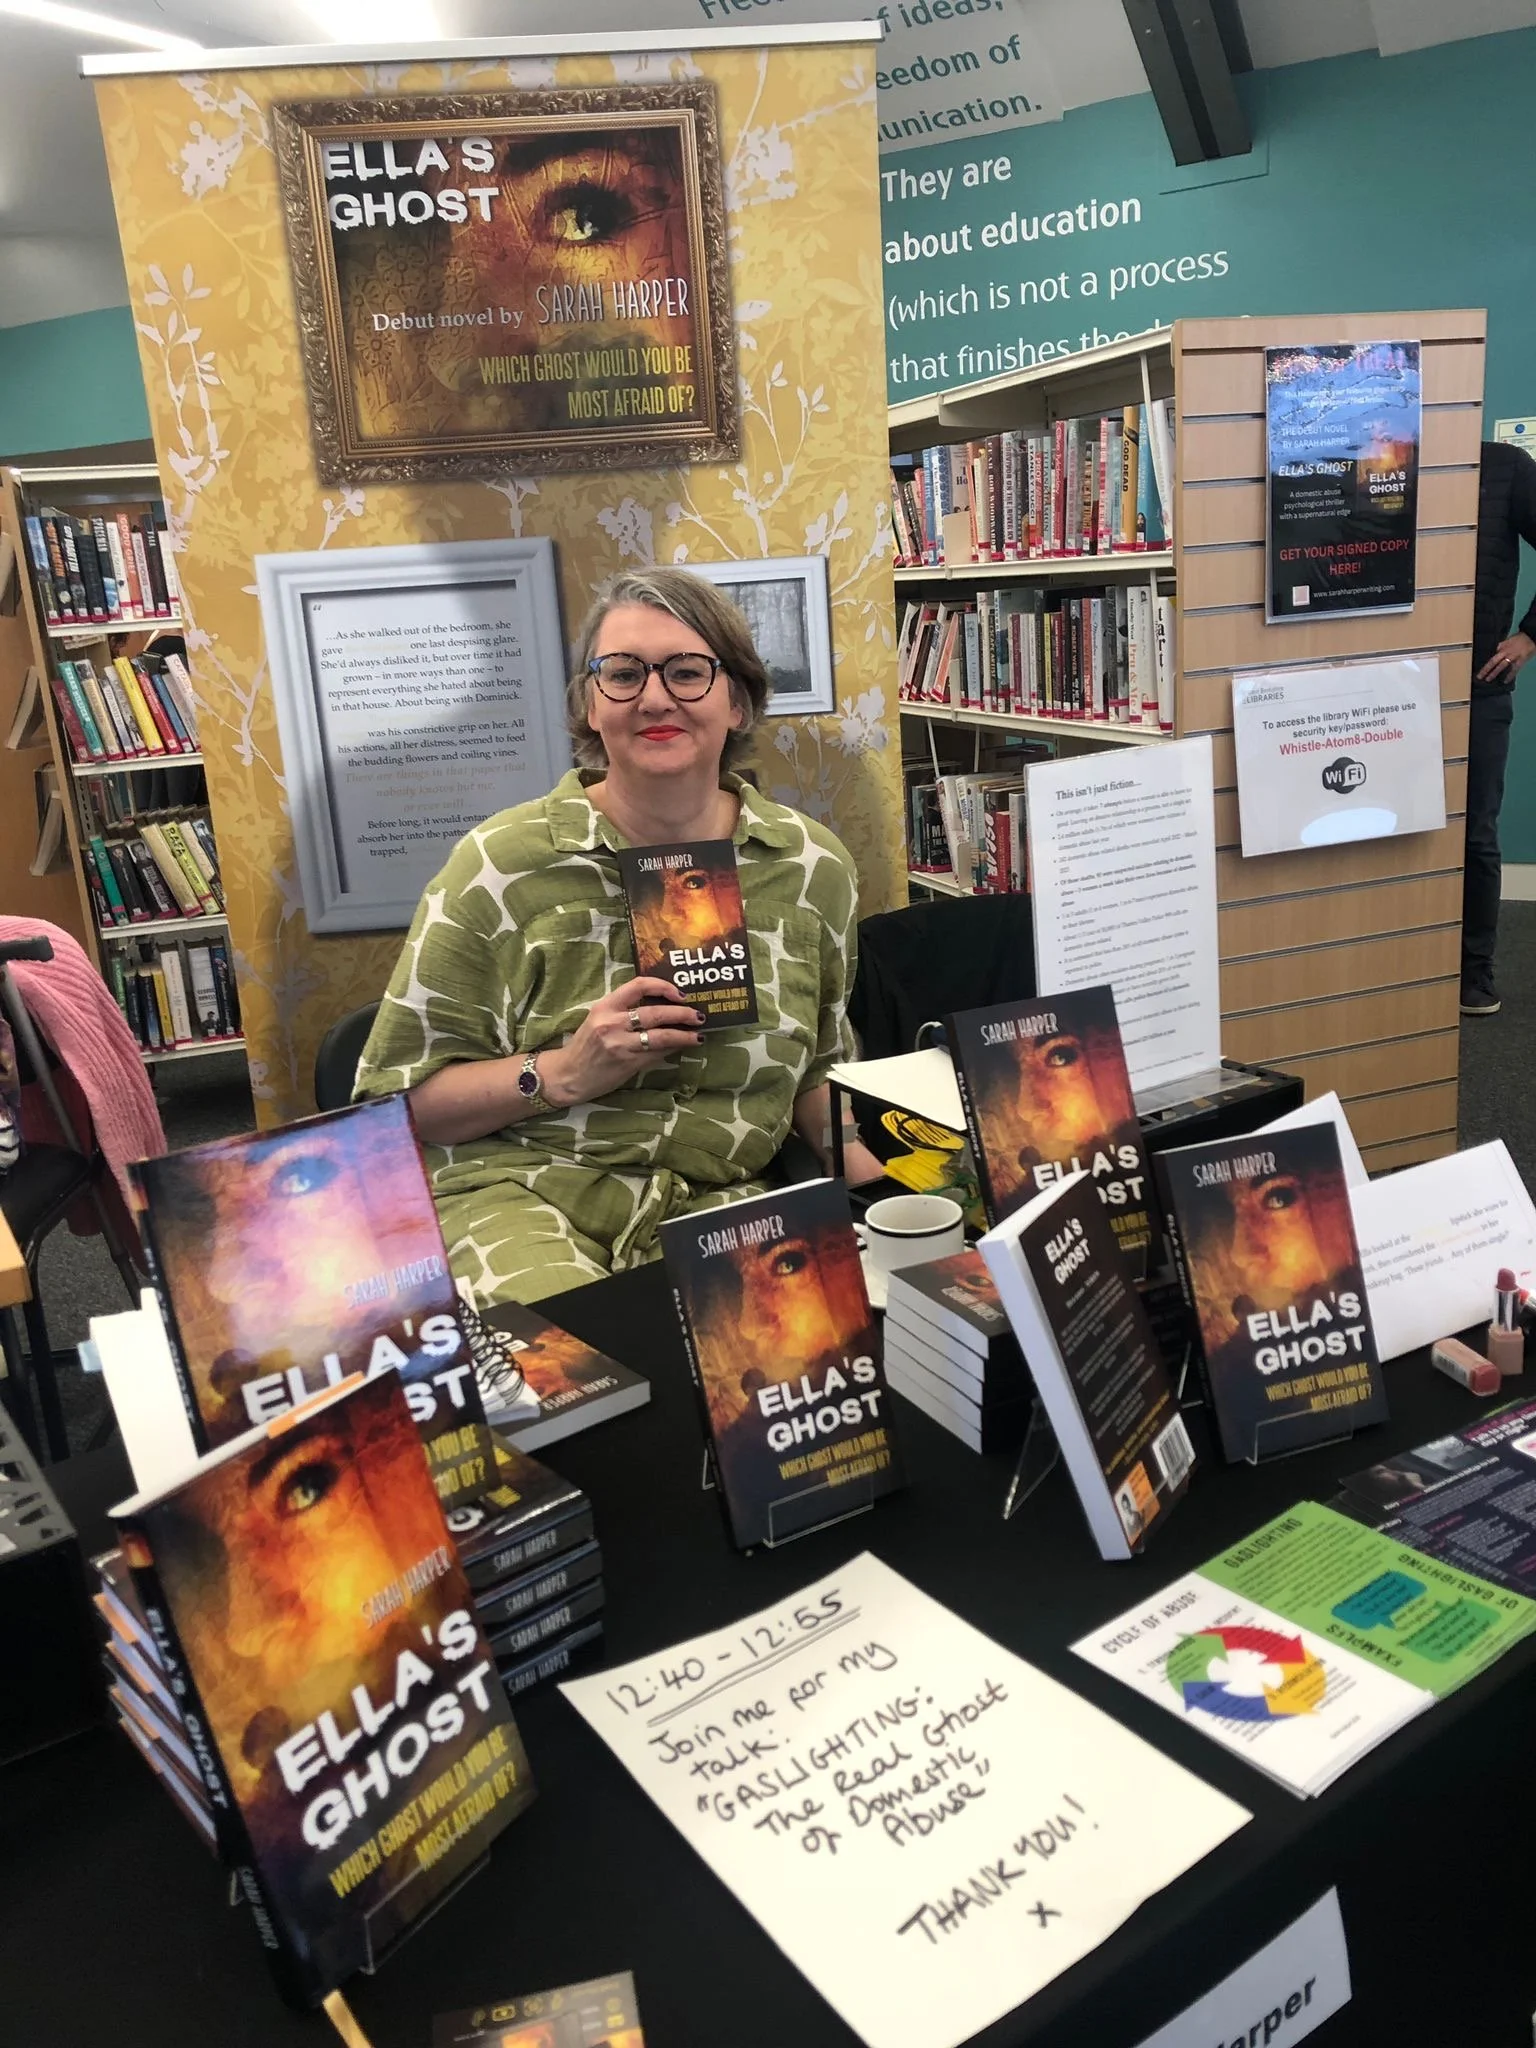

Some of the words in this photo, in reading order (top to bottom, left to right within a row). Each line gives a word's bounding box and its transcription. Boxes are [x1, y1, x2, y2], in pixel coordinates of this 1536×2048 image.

[876, 47, 981, 91] eedom
[989, 33, 1021, 65] of
[879, 91, 1042, 142] unication.
[323, 137, 496, 181] ELLA'S
[880, 165, 954, 202] They
[962, 154, 1012, 183] are
[329, 187, 499, 230] GHOST
[884, 227, 973, 264] about
[982, 197, 1141, 247] education
[372, 311, 436, 331] Debut
[439, 308, 494, 327] novel
[499, 309, 524, 328] by
[535, 286, 604, 325] SARAH
[613, 278, 689, 319] HARPER
[889, 283, 979, 329] (which
[989, 283, 1010, 311] is
[1019, 272, 1070, 303] not
[1080, 270, 1098, 296] a
[1110, 250, 1229, 300] process
[479, 355, 530, 386] WHICH
[534, 353, 580, 381] GHOST
[583, 350, 638, 379] WOULD
[642, 348, 673, 376] YOU
[674, 346, 693, 374] BE
[891, 347, 947, 383] that
[955, 334, 1071, 377] finishes
[568, 391, 610, 420] MOST
[614, 388, 665, 417] AFRAID
[668, 385, 695, 414] OF?
[1278, 464, 1314, 477] ELLA'S
[1316, 461, 1354, 474] GHOST
[1369, 471, 1406, 483] ELLA'S
[1369, 483, 1406, 494] GHOST
[1284, 500, 1324, 510] psychological
[1299, 510, 1336, 520] supernatural
[1337, 509, 1351, 517] edge
[1280, 548, 1303, 561] GET
[1304, 545, 1334, 558] YOUR
[1337, 542, 1378, 556] SIGNED
[1380, 539, 1409, 551] COPY
[1330, 562, 1361, 575] HERE!
[321, 647, 343, 657] gave
[410, 641, 427, 649] one
[429, 639, 445, 647] last
[447, 636, 491, 649] despising
[493, 635, 518, 646] glare.
[350, 630, 366, 639] she
[367, 627, 402, 638] walked
[404, 627, 420, 635] out
[421, 625, 431, 634] of
[433, 625, 448, 633] the
[449, 621, 493, 633] bedroom,
[495, 620, 511, 629] she
[320, 660, 346, 670] She'd
[348, 658, 380, 669] always
[382, 655, 419, 666] disliked
[433, 652, 448, 662] but
[451, 653, 470, 661] over
[473, 650, 494, 660] time
[495, 649, 502, 658] it
[504, 648, 522, 657] had
[1246, 692, 1284, 704] LIBRARIES
[1263, 721, 1274, 730] To
[1276, 717, 1305, 728] access
[1307, 714, 1321, 724] the
[1323, 710, 1350, 723] library
[1351, 708, 1371, 718] WiFi
[1372, 704, 1399, 716] please
[1401, 702, 1416, 710] use
[1279, 728, 1404, 755] Whistle-Atom8-Double
[1293, 727, 1326, 738] security
[1328, 718, 1389, 734] key/password:
[1056, 788, 1073, 801] This
[1075, 784, 1092, 797] isn't
[1093, 781, 1109, 796] just
[638, 857, 663, 872] SARAH
[665, 853, 694, 868] HARPER
[669, 942, 745, 967] ELLA'S
[673, 965, 747, 987] GHOST
[980, 1022, 1016, 1046] SARAH
[1018, 1013, 1060, 1038] HARPER
[1192, 1159, 1231, 1188] SARAH
[1233, 1151, 1276, 1180] HARPER
[698, 1226, 738, 1259] SARAH
[740, 1214, 785, 1248] HARPER
[1043, 1217, 1083, 1262] ELLA'S
[1054, 1238, 1091, 1285] GHOST
[1246, 1291, 1362, 1342] ELLA'S
[1255, 1325, 1365, 1376] GHOST
[757, 1355, 877, 1418] ELLA'S
[766, 1390, 883, 1453] GHOST
[361, 1578, 405, 1630] SARAH
[403, 1546, 451, 1596] HARPER
[1101, 1626, 1141, 1655] CYCLE
[1141, 1614, 1162, 1629] OF
[1160, 1591, 1199, 1618] ABUSE
[606, 1656, 705, 1715] 12:40
[740, 1588, 843, 1659] 12:55
[273, 1609, 479, 1794] ELLA'S
[647, 1724, 727, 1764] Join
[731, 1699, 776, 1728] me
[788, 1670, 828, 1712] for
[837, 1641, 899, 1674] my
[301, 1661, 497, 1852] GHOST
[689, 1729, 791, 1782] talk:
[753, 1797, 825, 1836] The
[833, 1741, 913, 1797] Real
[922, 1677, 1010, 1748] Ghost
[329, 1837, 381, 1899] WHICH
[378, 1800, 422, 1857] GHOST
[418, 1760, 468, 1820] WOULD
[462, 1739, 492, 1778] YOU
[488, 1724, 509, 1759] BE
[452, 1781, 496, 1839] AFRAID
[492, 1760, 517, 1799] OF?
[801, 1826, 843, 1855] of
[848, 1746, 977, 1828] Domestic
[895, 1857, 1027, 1945] THANK
[1013, 1794, 1102, 1863] YOU!
[1219, 1976, 1316, 2048] arper
